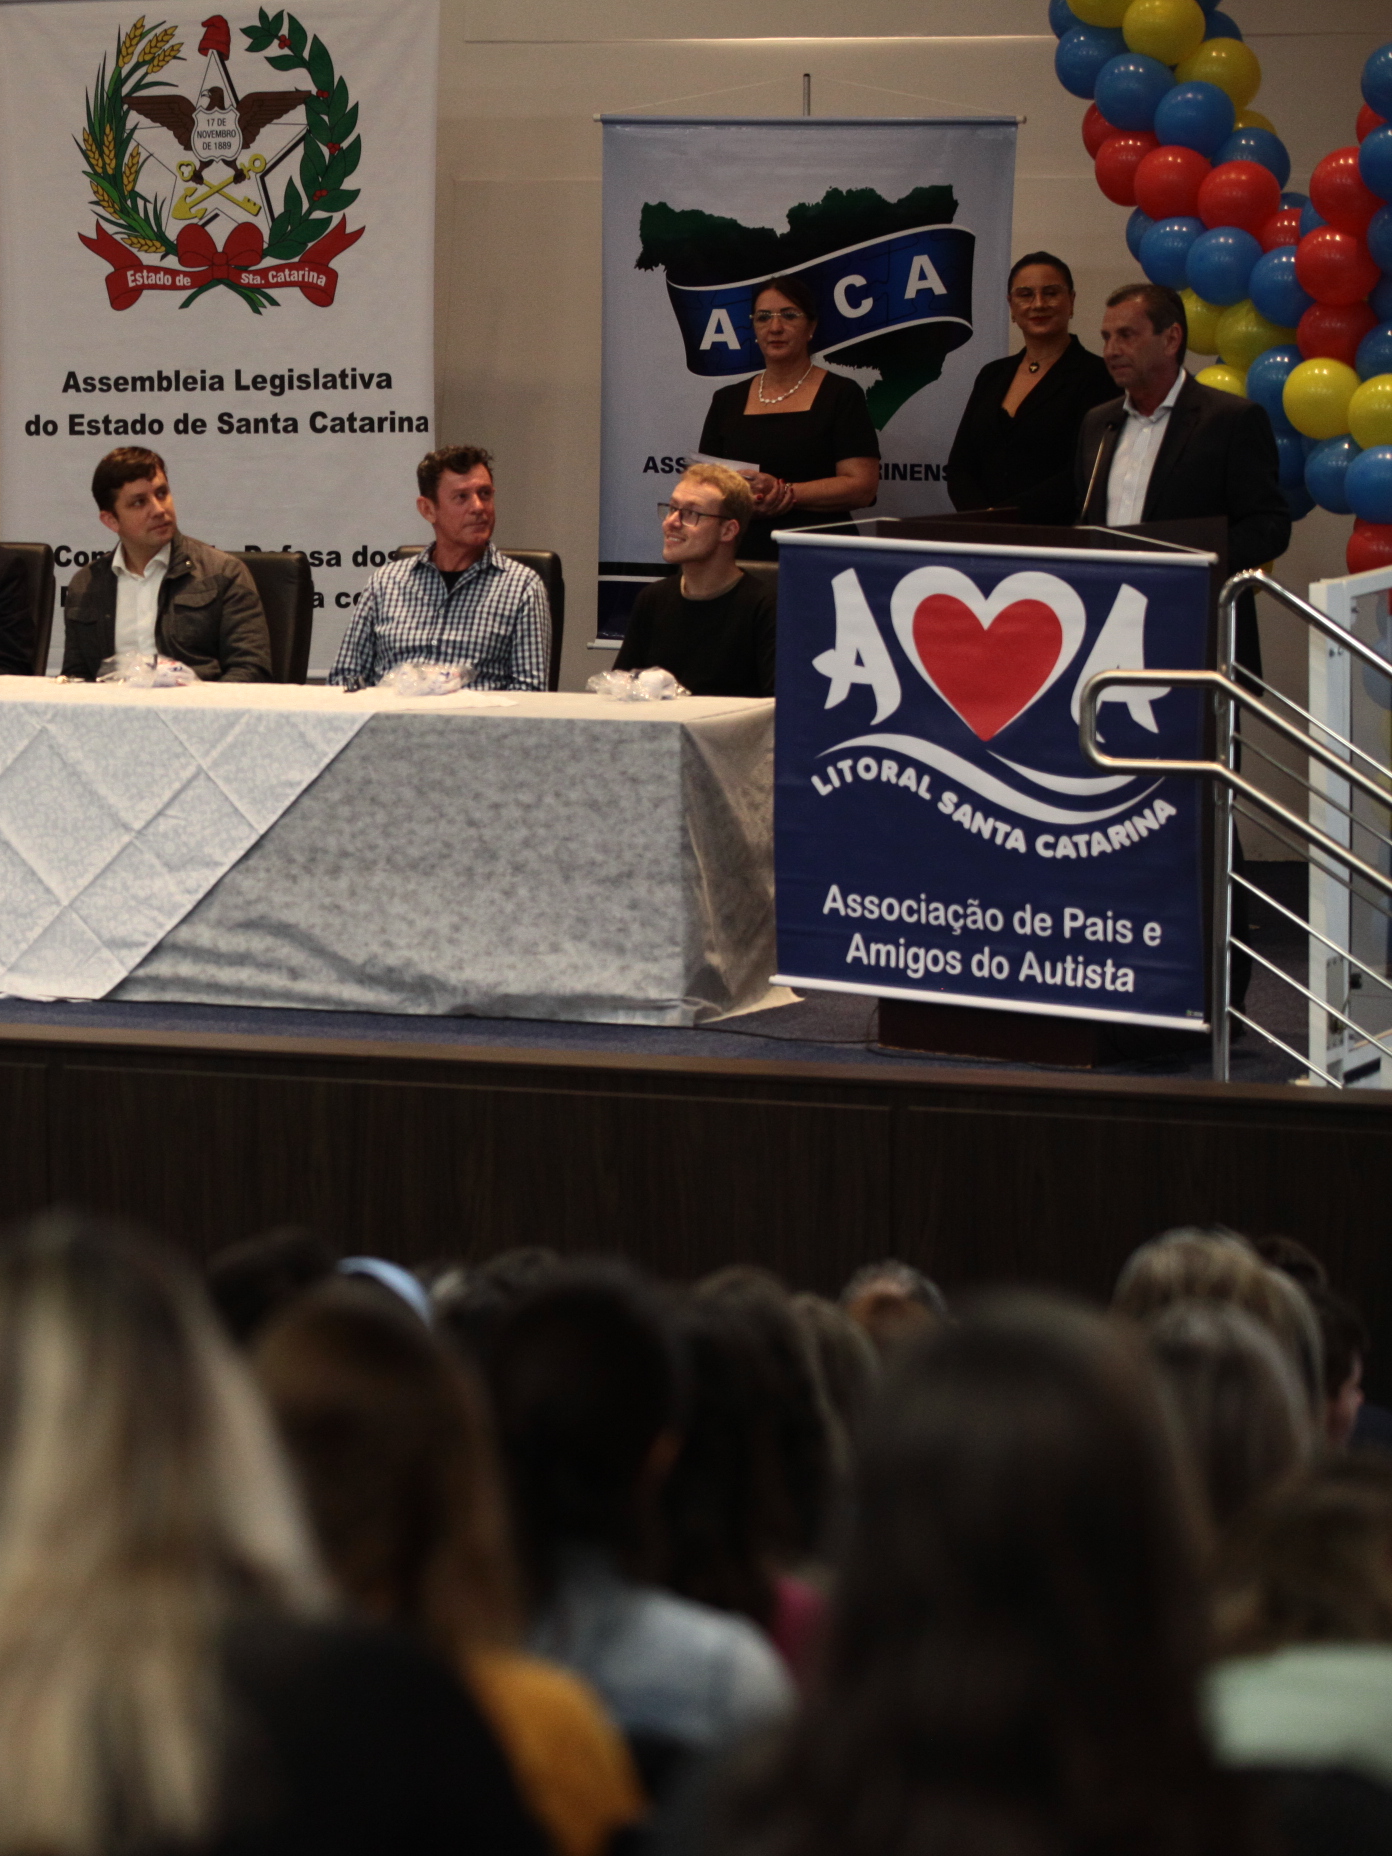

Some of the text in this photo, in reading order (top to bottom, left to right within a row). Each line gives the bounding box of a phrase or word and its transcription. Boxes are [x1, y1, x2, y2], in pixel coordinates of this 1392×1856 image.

[197, 130, 236, 138] NOVEMBRO
[207, 118, 226, 127] 17 DE
[203, 141, 232, 150] DE 1889
[127, 268, 327, 287] Estado de Sta. Catarina
[62, 368, 393, 396] Assembleia Legislativa
[25, 410, 429, 436] do Estado de Santa Catarina
[811, 757, 1177, 859] LITORAL SANTA CATARINA
[823, 884, 1162, 946] Associação de Pais e
[846, 933, 1135, 993] Amigos do Autista
